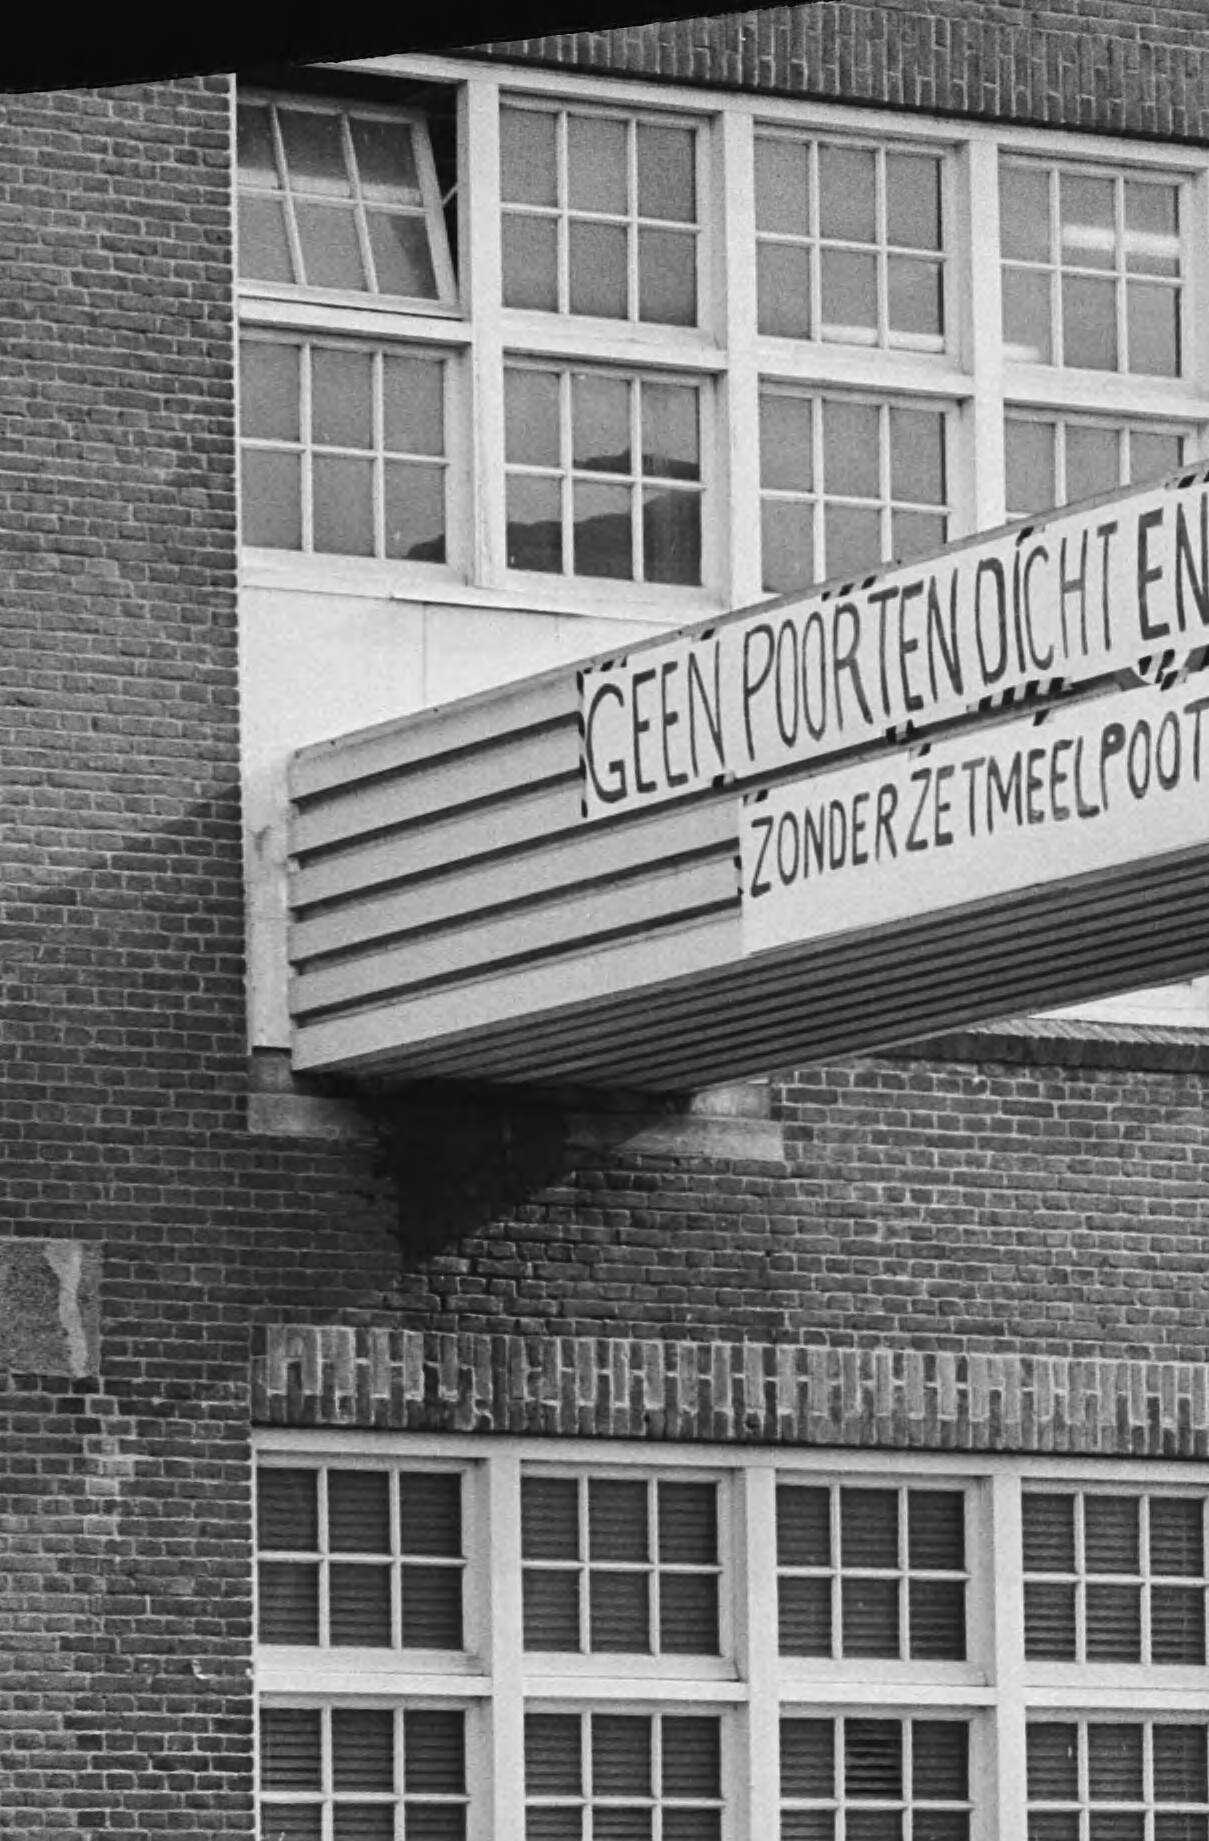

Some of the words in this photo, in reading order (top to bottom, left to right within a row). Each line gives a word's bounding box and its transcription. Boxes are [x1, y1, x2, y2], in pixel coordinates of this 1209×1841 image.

[585, 640, 729, 804] GEEN
[742, 567, 965, 761] POORTEN
[750, 782, 898, 898] ZONDER
